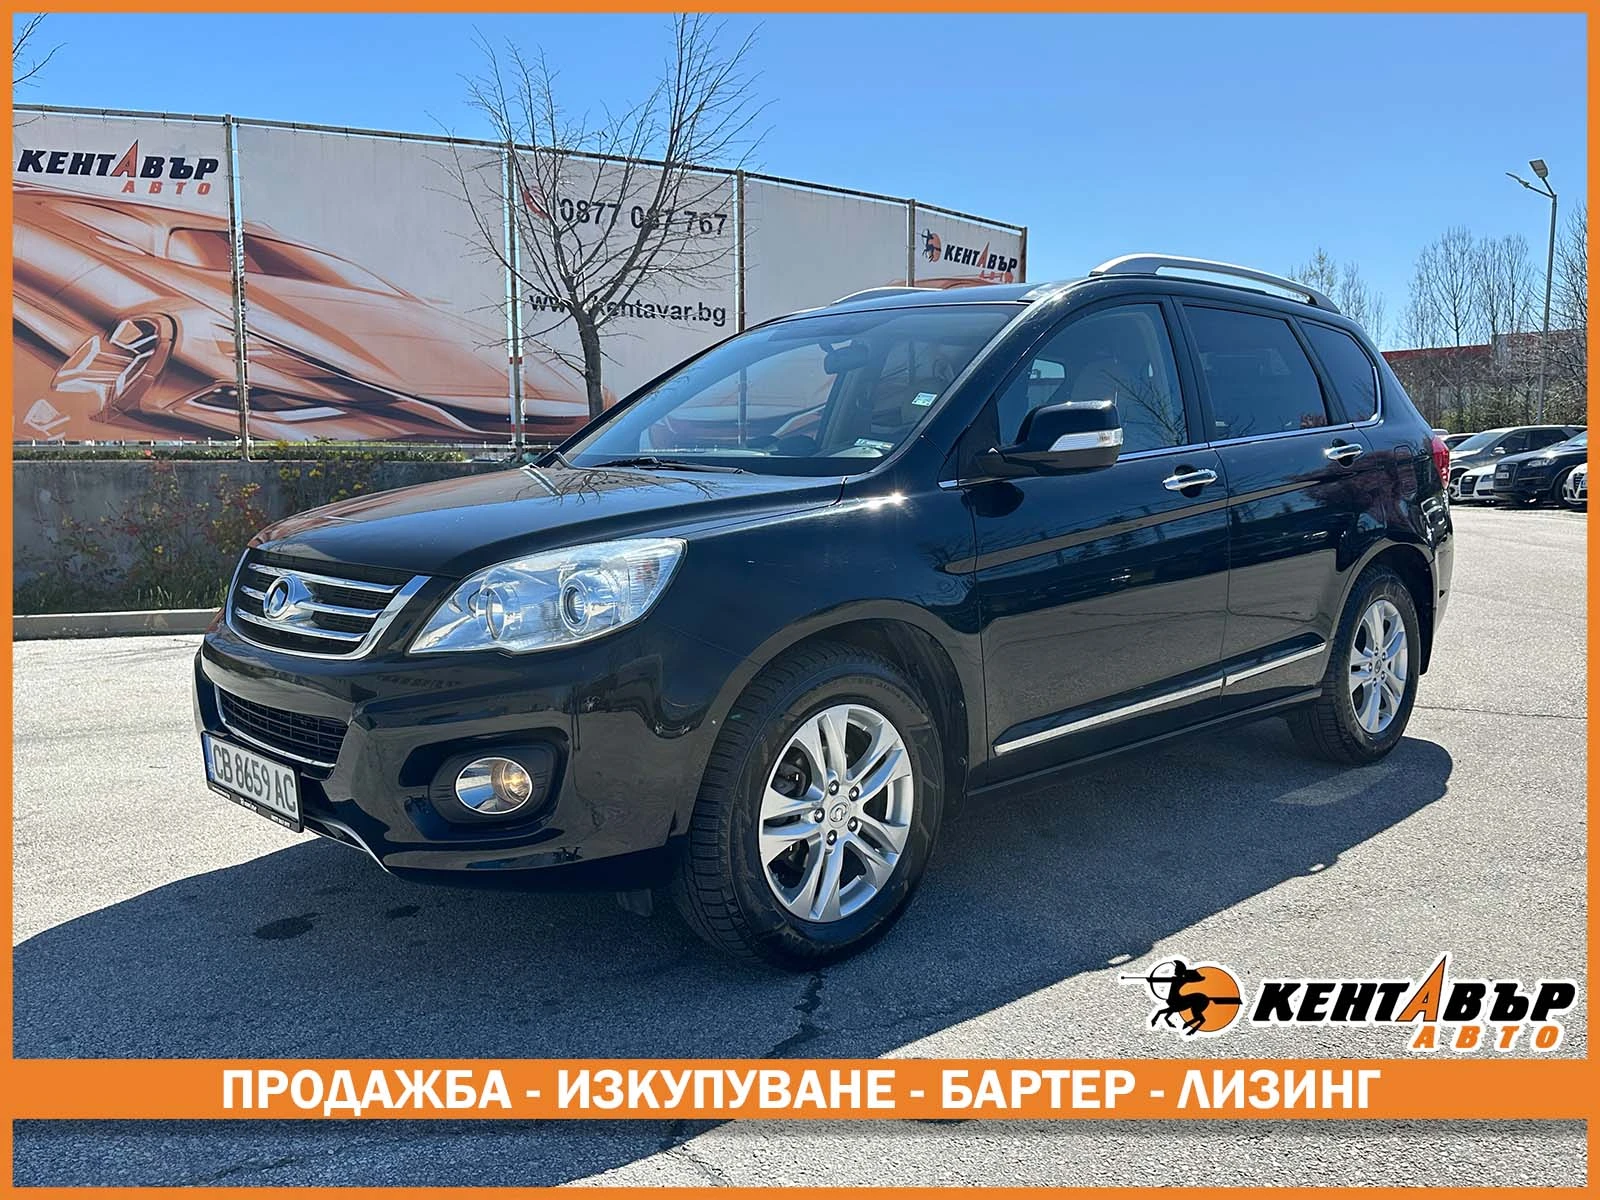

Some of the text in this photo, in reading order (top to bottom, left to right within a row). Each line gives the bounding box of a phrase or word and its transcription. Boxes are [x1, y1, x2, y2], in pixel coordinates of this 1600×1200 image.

[17, 139, 219, 180] КЕНТАВЪР
[121, 180, 212, 195] АВТО
[560, 198, 621, 225] 0877
[684, 211, 728, 236] 767
[944, 241, 1018, 273] КЕНТАВЪР
[529, 295, 726, 327] wwkentavar.bg
[235, 753, 271, 801] 8659
